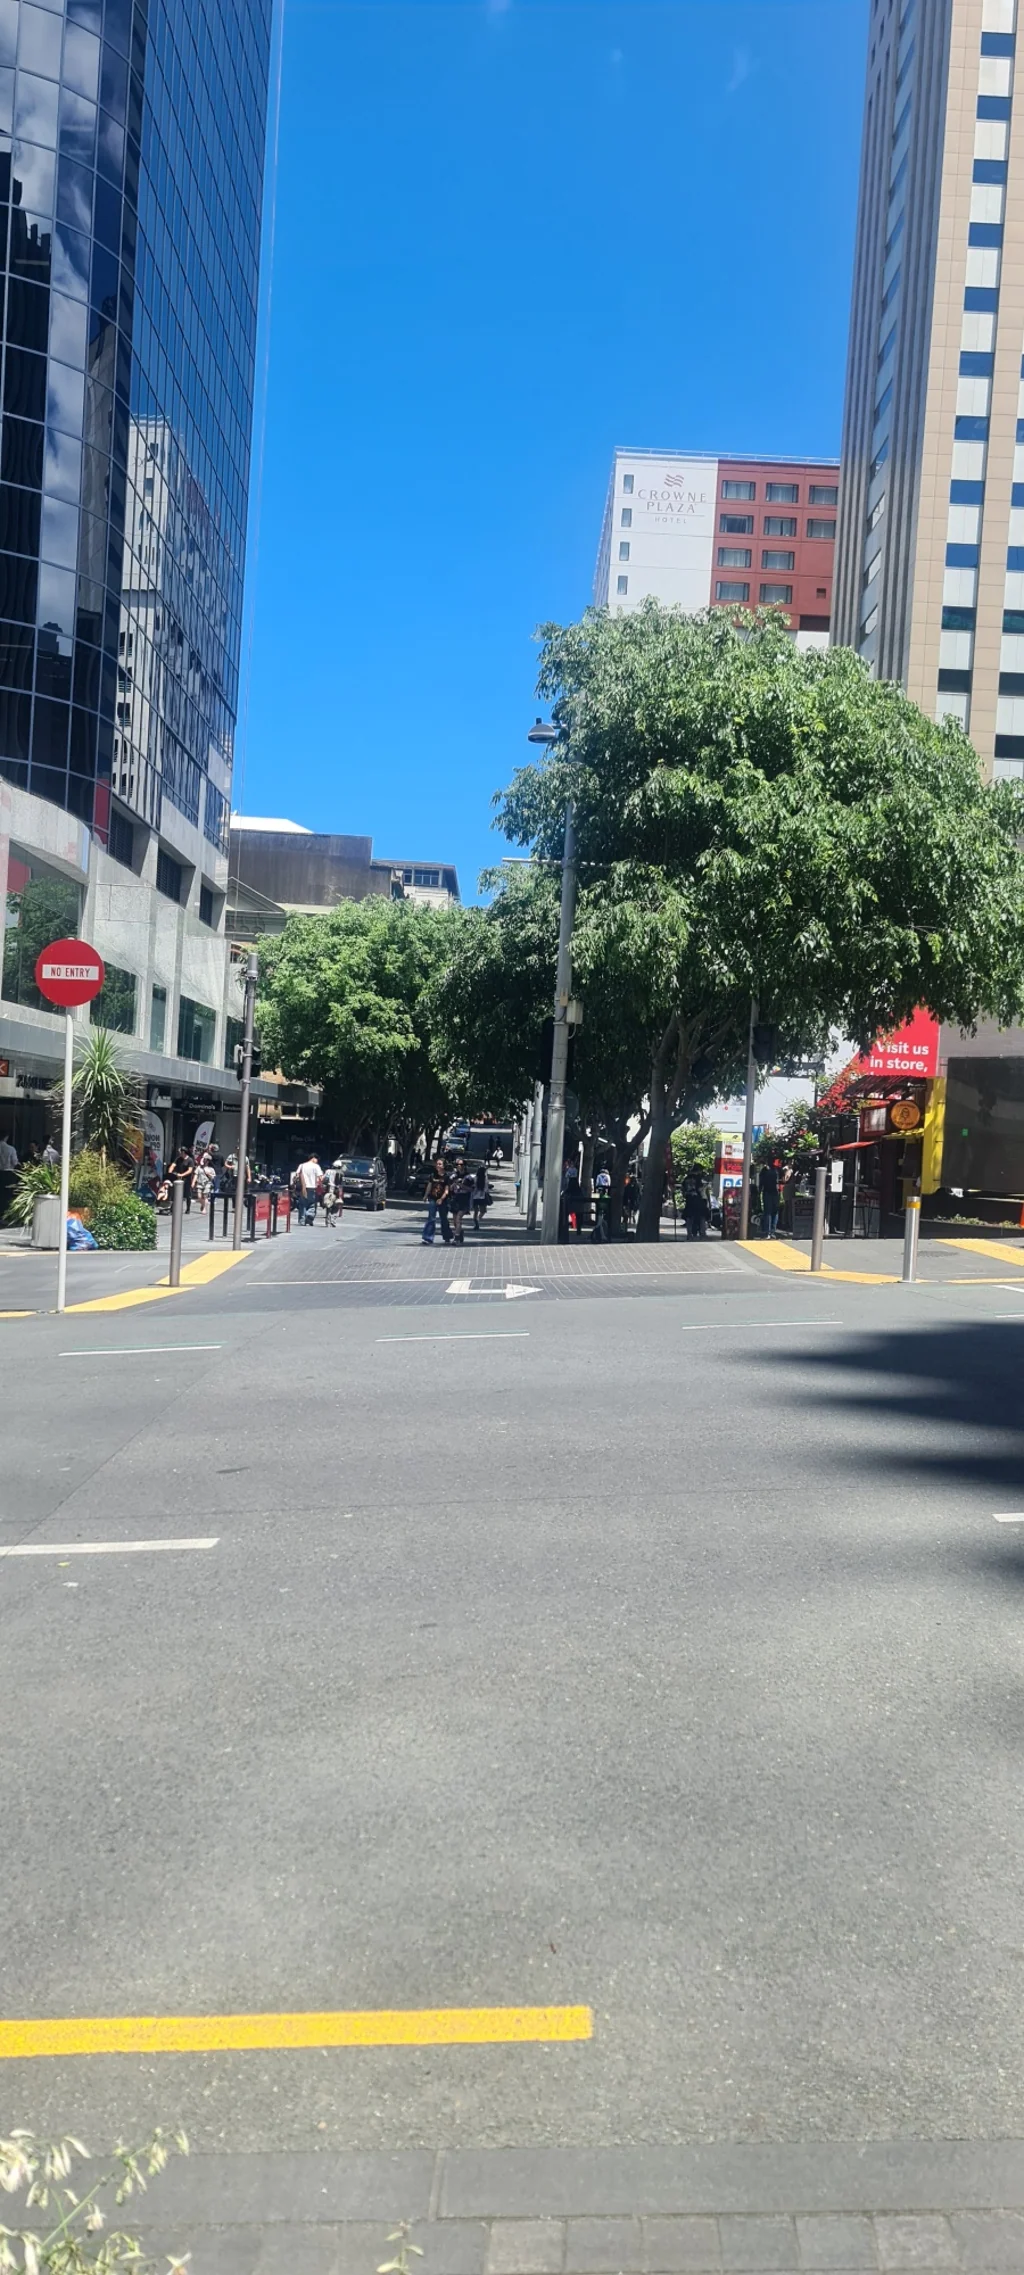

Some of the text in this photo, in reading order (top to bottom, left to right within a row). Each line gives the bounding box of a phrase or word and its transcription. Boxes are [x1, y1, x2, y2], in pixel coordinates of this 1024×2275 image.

[637, 488, 707, 503] CROWNE
[646, 501, 695, 514] PLAZA
[654, 516, 687, 524] HOTEL
[51, 967, 91, 978] NO ENTRY
[876, 1040, 929, 1055] Visit us
[869, 1055, 928, 1073] in store,
